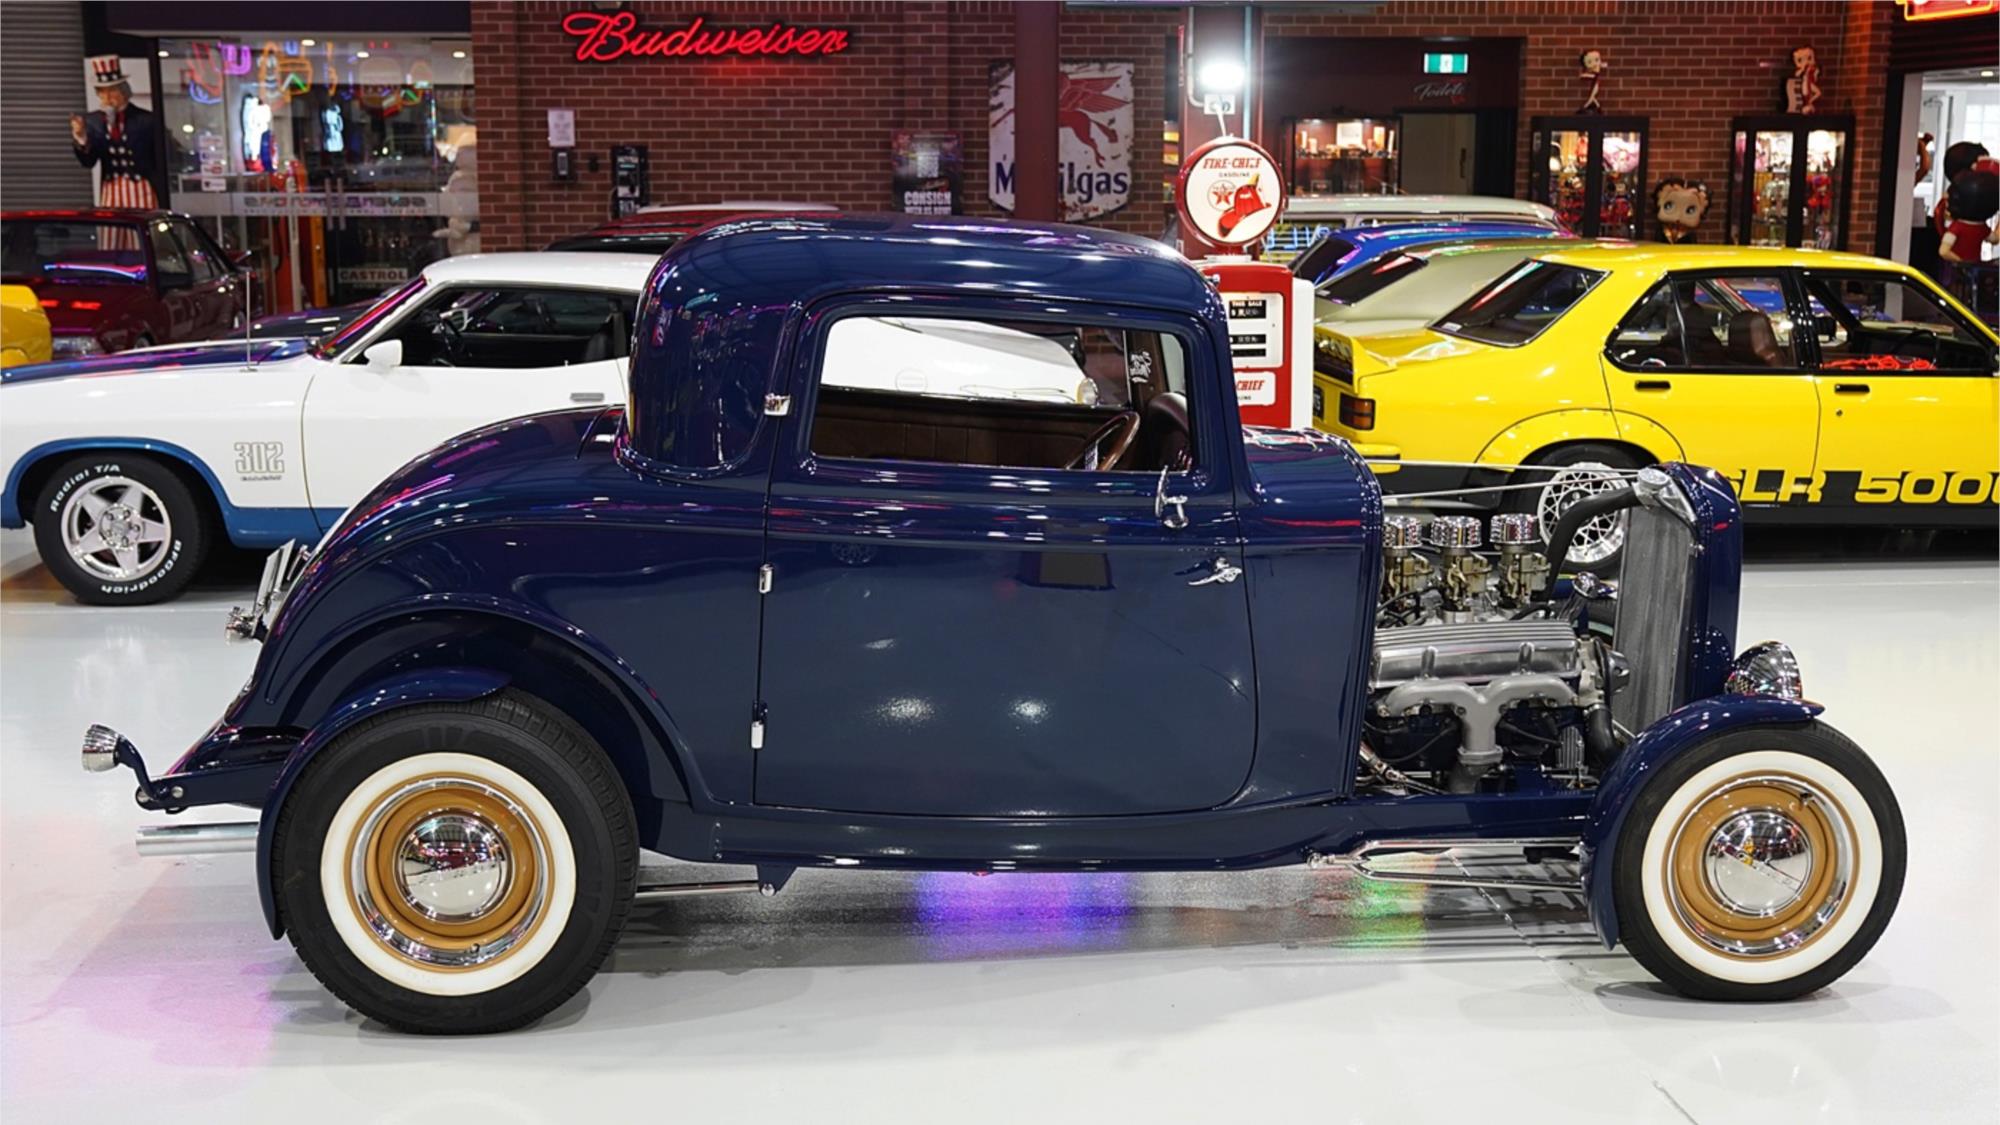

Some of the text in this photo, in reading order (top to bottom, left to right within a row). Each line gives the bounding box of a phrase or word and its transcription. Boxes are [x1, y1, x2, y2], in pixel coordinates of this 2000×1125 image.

[562, 11, 849, 61] Budweiser
[904, 191, 952, 205] CONSIGN
[995, 161, 1129, 204] Milgas
[339, 270, 407, 281] CASTROL
[234, 441, 285, 474] 302
[50, 464, 121, 512] Radial T/A
[1855, 470, 2000, 504] 500
[101, 539, 182, 594] BFGoodrich
